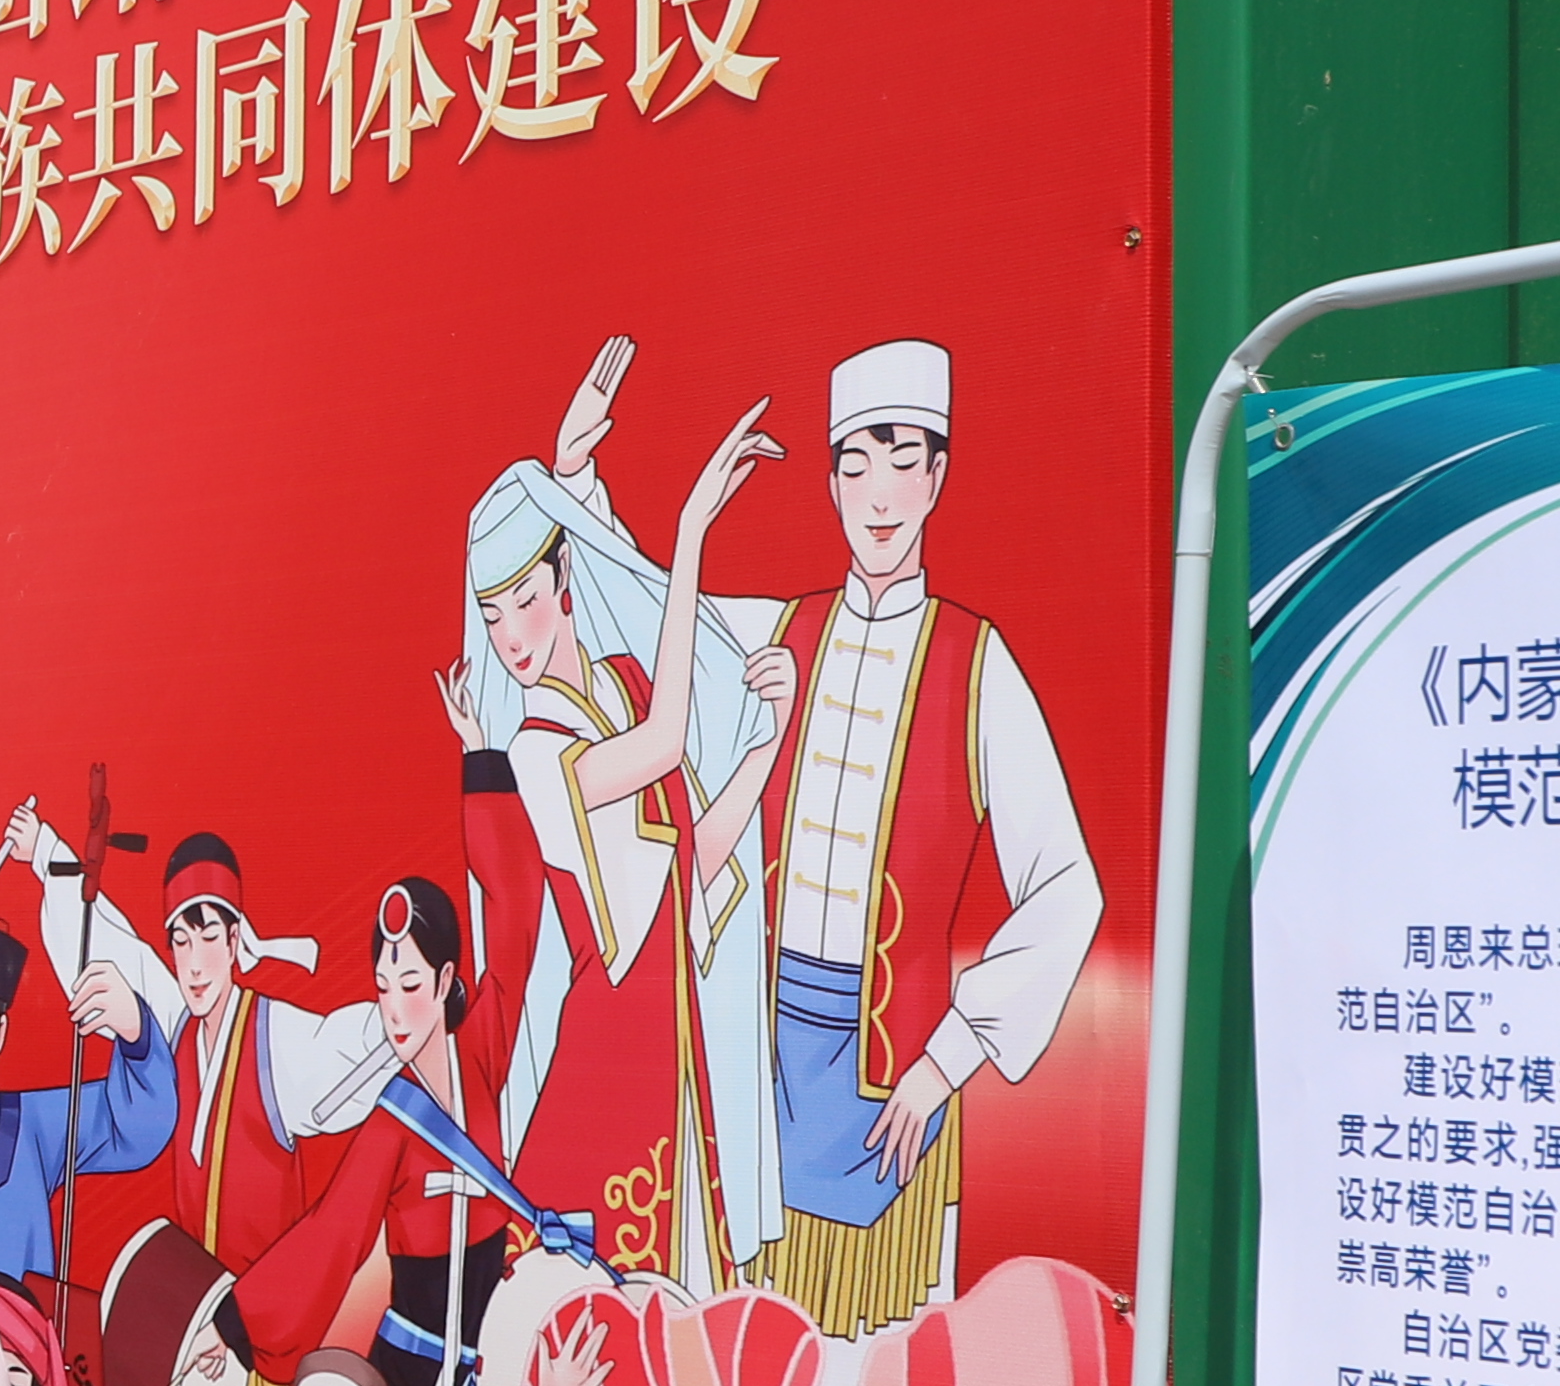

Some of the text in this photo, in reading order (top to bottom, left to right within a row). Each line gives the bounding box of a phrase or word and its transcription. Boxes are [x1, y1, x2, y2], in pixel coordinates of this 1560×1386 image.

[1403, 924, 1560, 971] 周恩来总
[1403, 1052, 1560, 1104] 建设好模
[1336, 1176, 1558, 1238] 设好模范自治
[1336, 1238, 1508, 1299] 崇高荣誉”。
[1403, 1310, 1560, 1369] 自治区党
